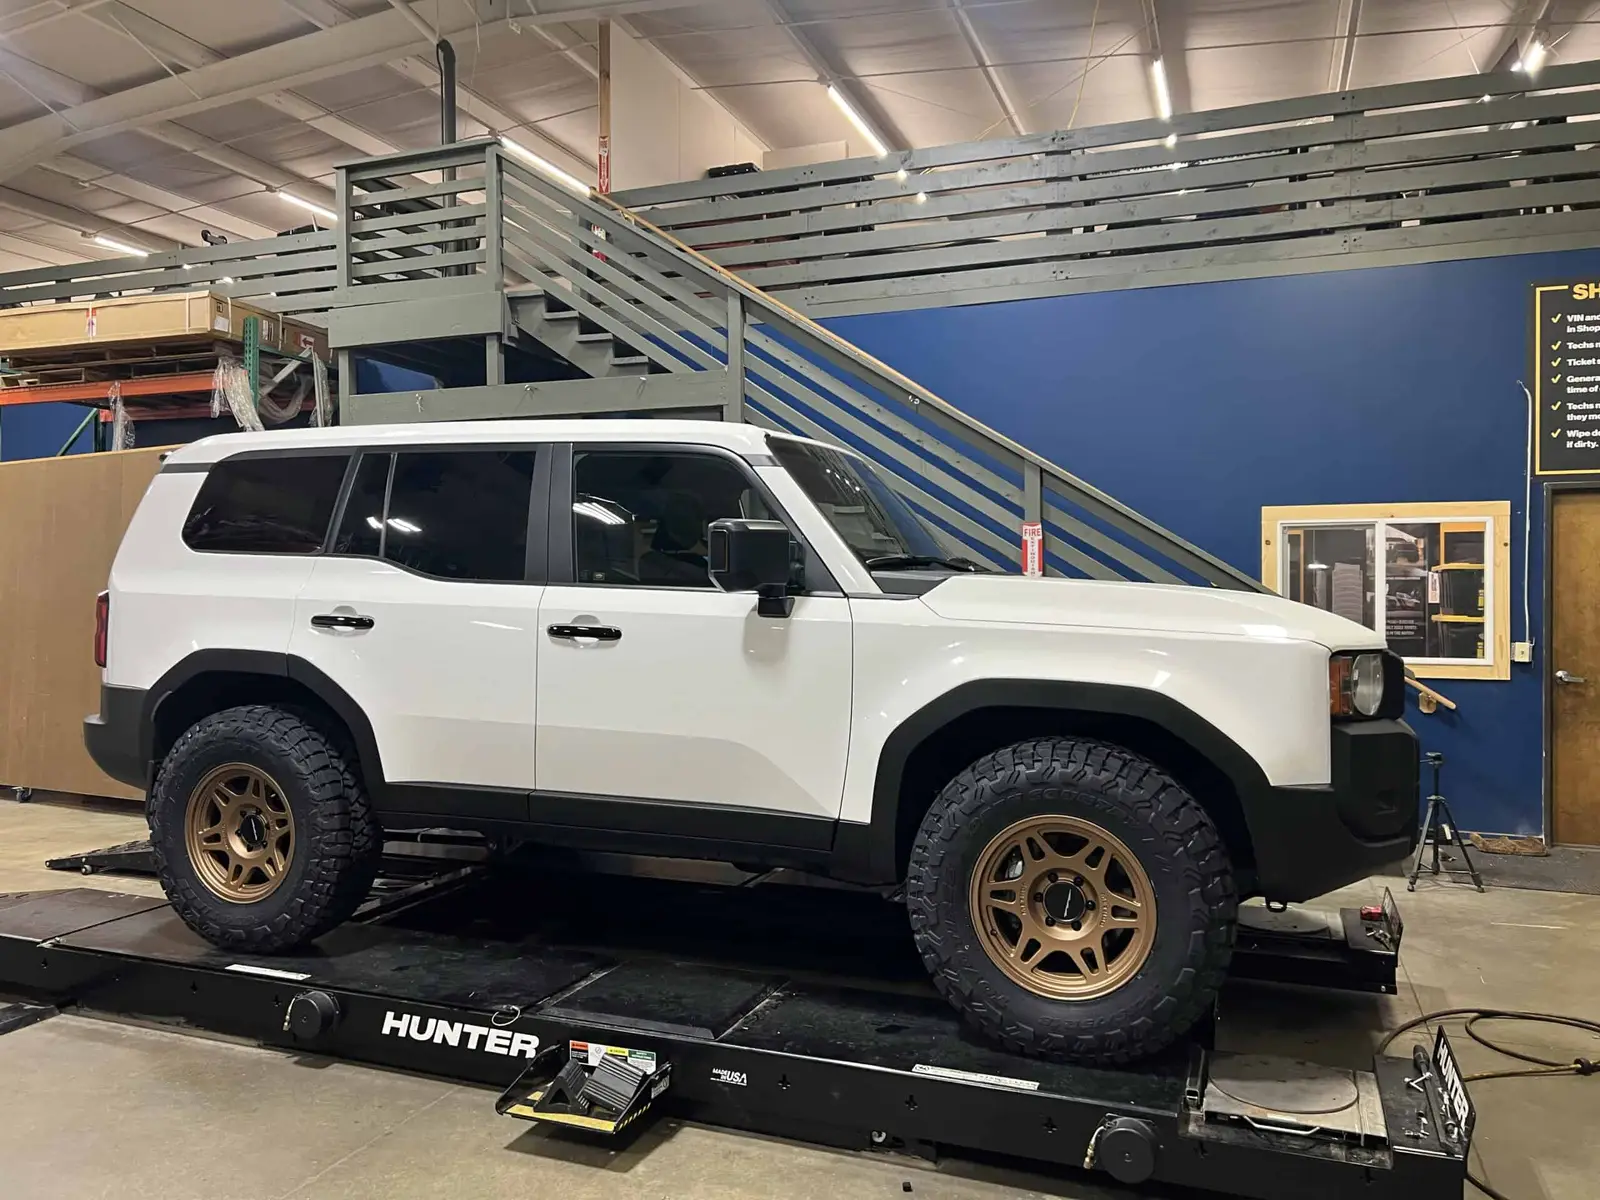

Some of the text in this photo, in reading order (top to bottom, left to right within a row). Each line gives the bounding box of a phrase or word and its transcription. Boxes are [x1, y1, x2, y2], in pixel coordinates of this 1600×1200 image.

[1572, 283, 1600, 299] SH
[1566, 313, 1584, 322] VIN
[1566, 341, 1594, 349] Techs
[1566, 357, 1596, 366] Ticket
[1566, 384, 1599, 393] time of
[1566, 402, 1594, 410] Techs
[1566, 413, 1587, 421] they
[1566, 429, 1590, 438] Wipe
[1574, 440, 1599, 449] dirty.
[1024, 528, 1041, 536] FIRE
[381, 1011, 540, 1059] HUNTER
[727, 1070, 748, 1083] USA
[1437, 1037, 1469, 1132] HUNTER
